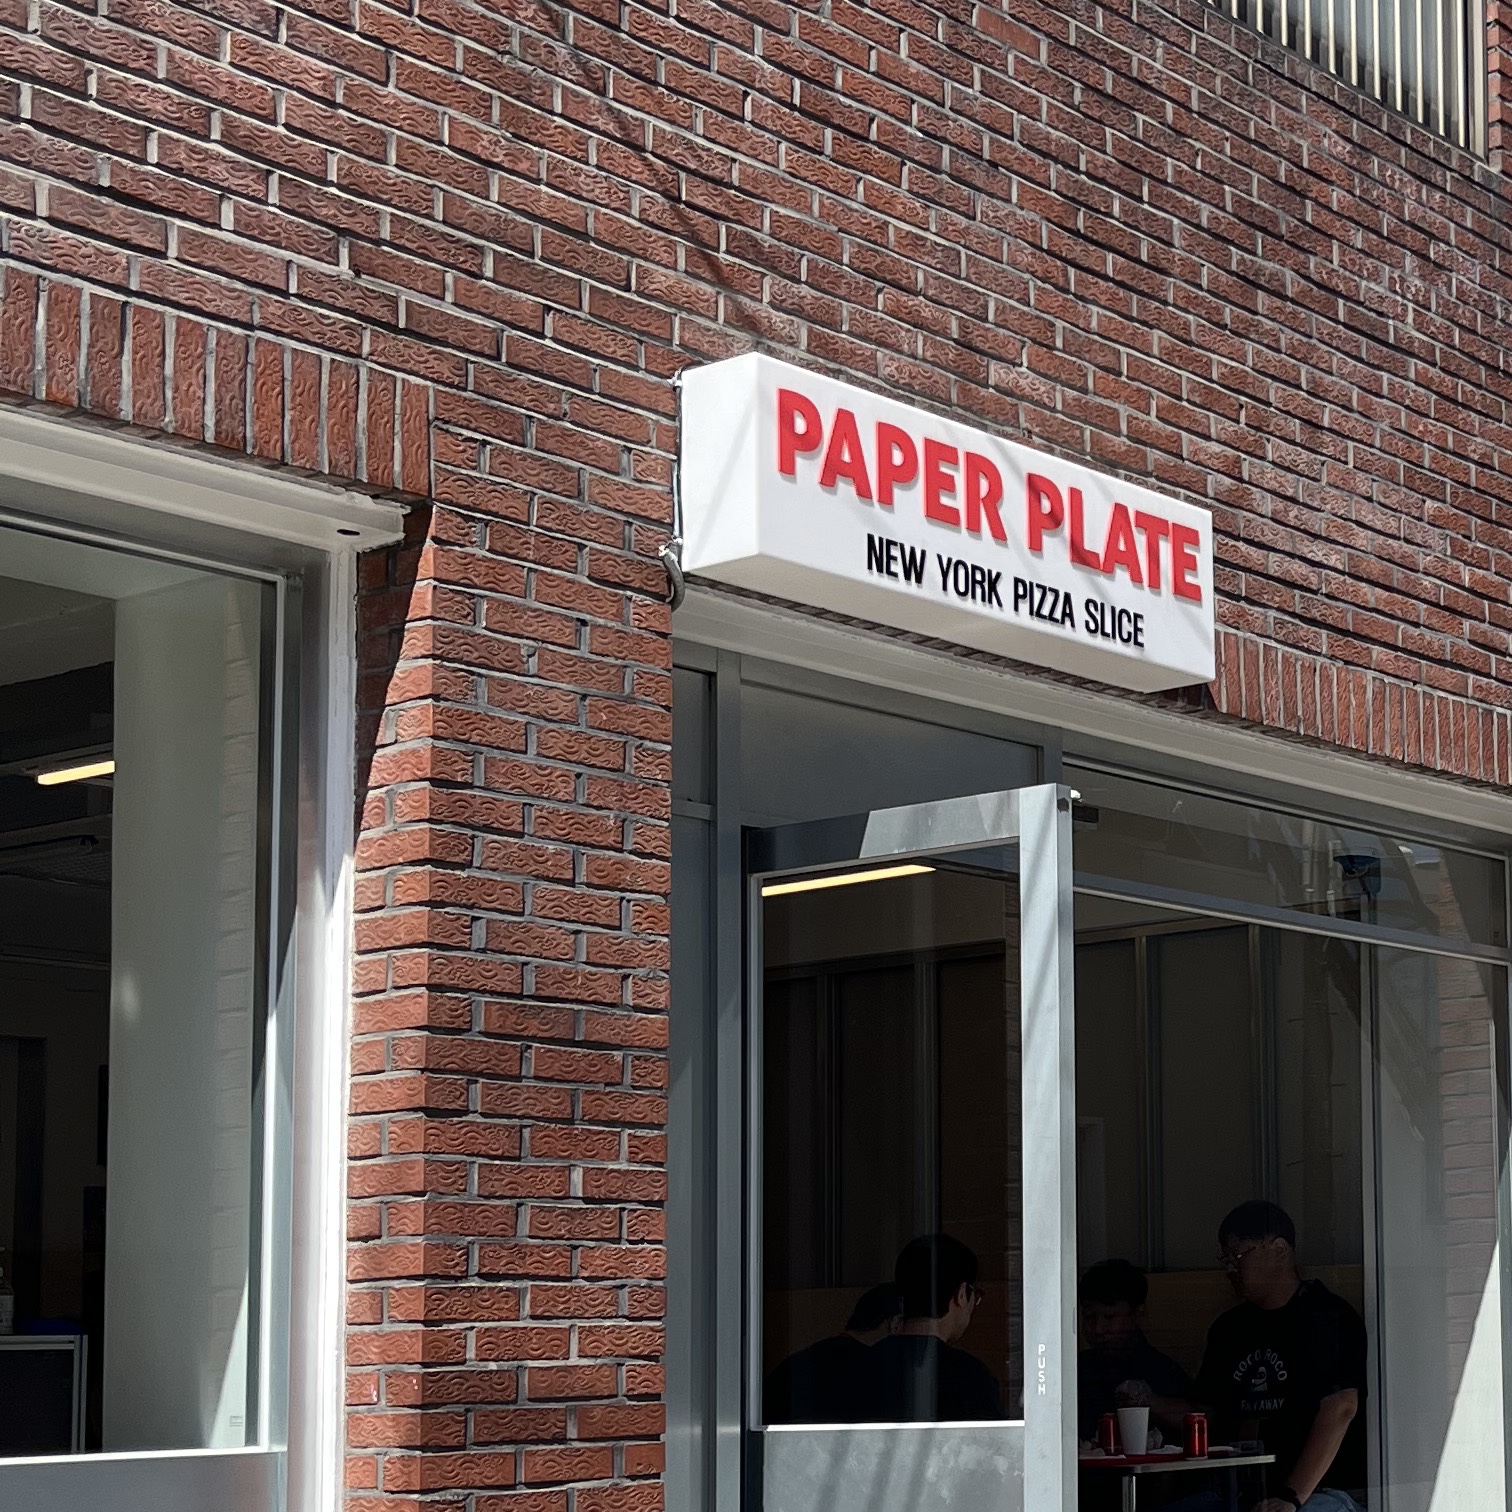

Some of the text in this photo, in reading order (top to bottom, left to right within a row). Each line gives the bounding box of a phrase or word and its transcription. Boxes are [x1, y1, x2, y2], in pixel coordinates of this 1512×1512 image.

[778, 388, 1202, 601] PAPER PLATE
[867, 534, 1145, 648] NEW YORK PIZZA SLICE
[1038, 1343, 1046, 1396] PUSH
[1233, 1348, 1288, 1381] ROCO ROCO
